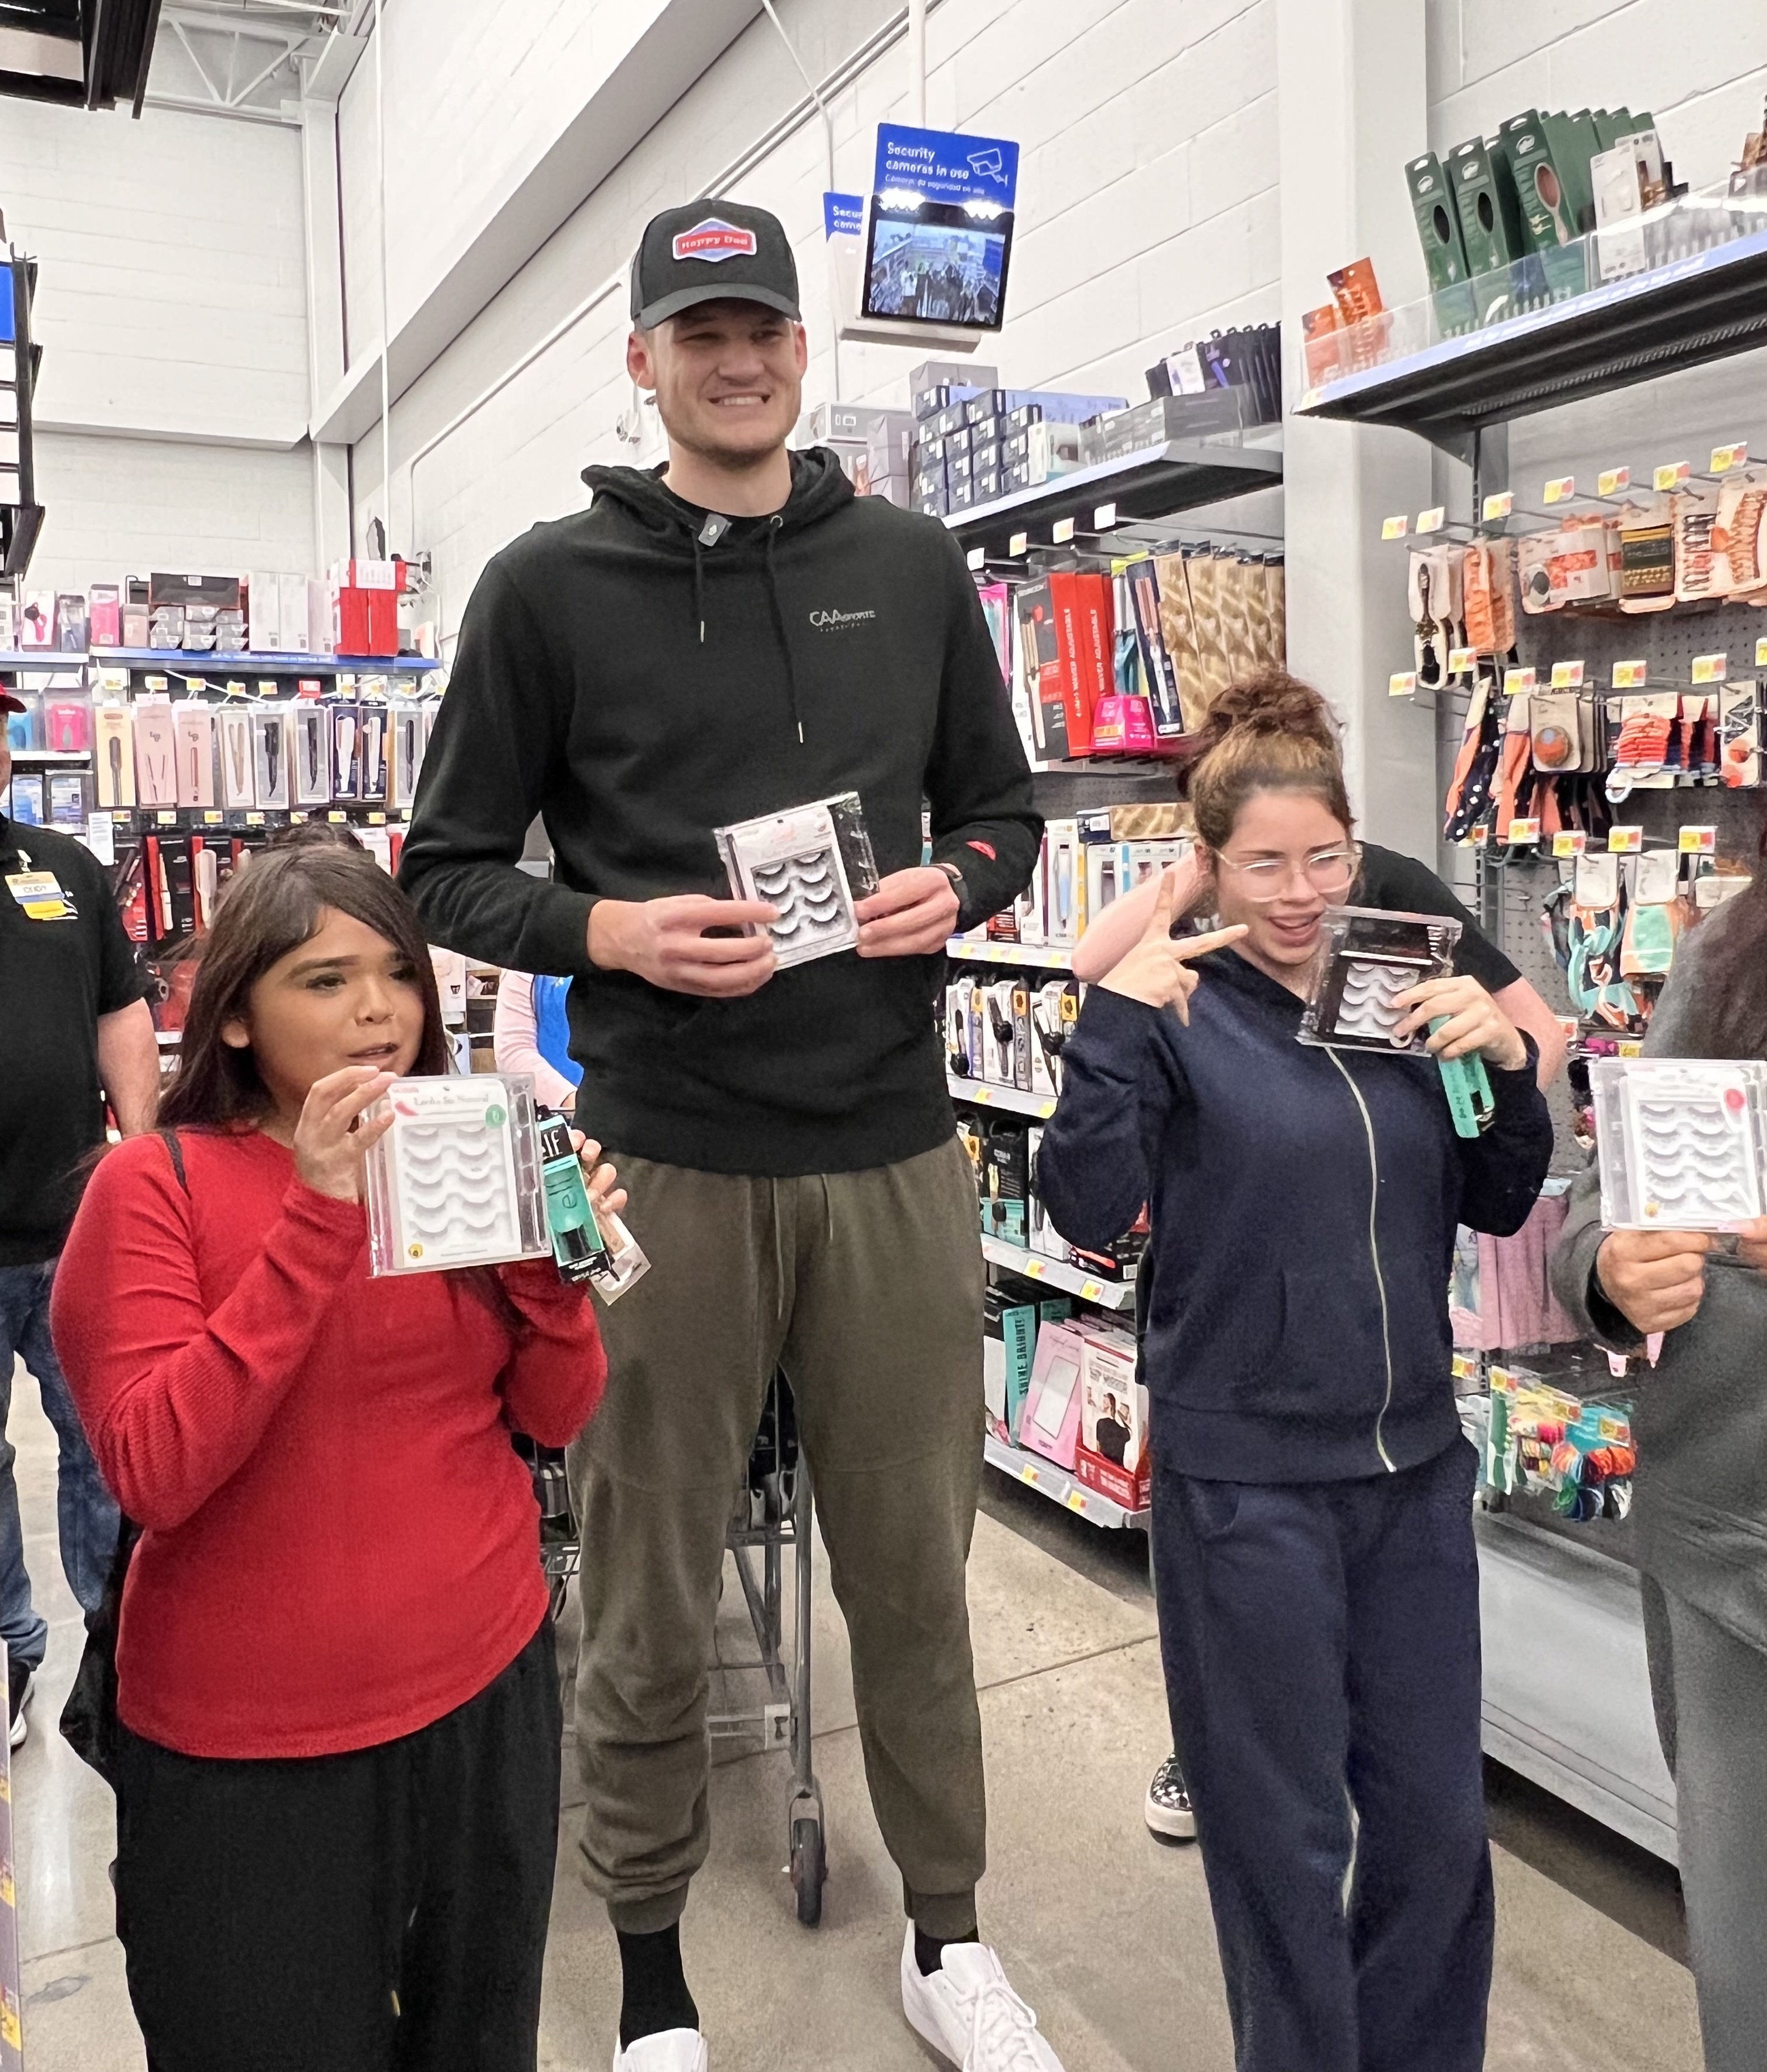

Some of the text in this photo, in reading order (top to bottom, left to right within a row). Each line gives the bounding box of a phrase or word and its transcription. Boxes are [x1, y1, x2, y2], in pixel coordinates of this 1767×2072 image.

[888, 142, 935, 163] Security
[886, 160, 969, 179] cameras in use
[682, 236, 721, 249] Happy
